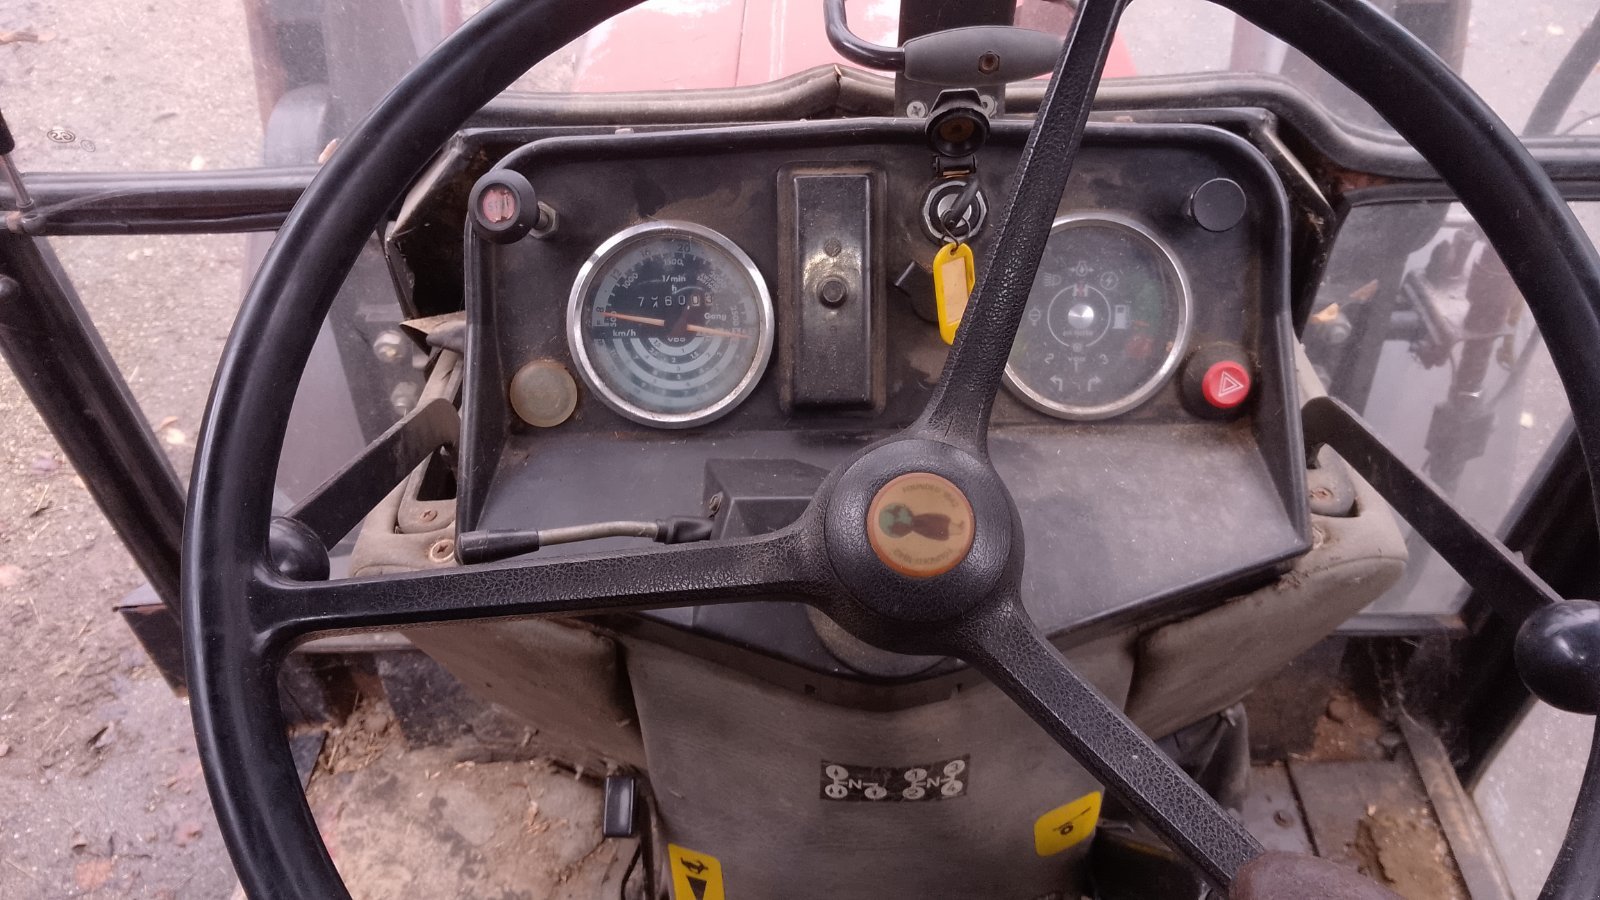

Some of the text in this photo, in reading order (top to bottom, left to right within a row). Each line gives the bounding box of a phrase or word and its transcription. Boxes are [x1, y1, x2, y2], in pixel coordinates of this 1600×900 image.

[621, 272, 639, 289] 1000
[612, 329, 637, 337] km/h
[848, 778, 862, 790] N
[926, 776, 940, 788] N
